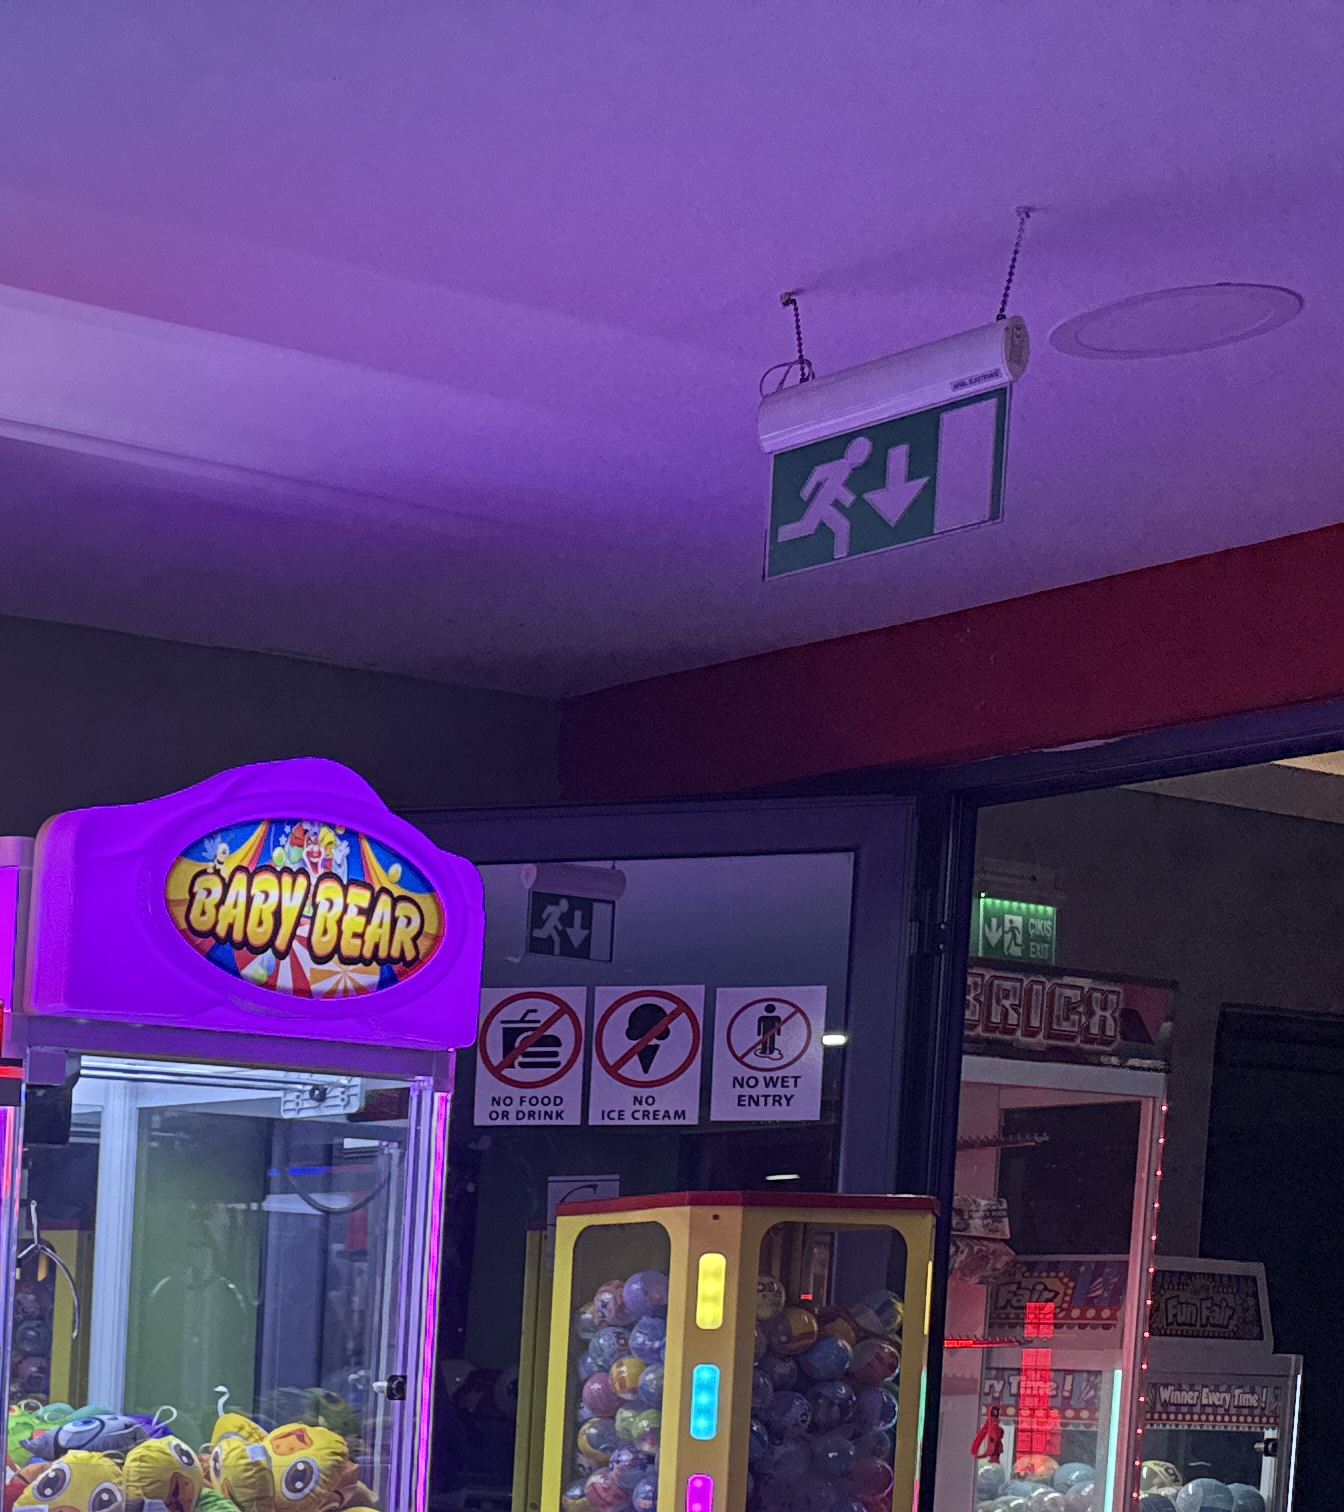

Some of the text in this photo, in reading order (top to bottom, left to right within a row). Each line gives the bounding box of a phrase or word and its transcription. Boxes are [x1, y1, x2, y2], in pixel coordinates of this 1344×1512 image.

[187, 864, 425, 964] BABY BEAR
[1029, 942, 1051, 958] EXIT
[732, 1075, 802, 1089] NO WET
[490, 1095, 565, 1108] NO FOOD
[632, 1094, 656, 1107] NO
[736, 1093, 795, 1108] ENTRY
[488, 1109, 565, 1122] OR DRINK
[600, 1109, 687, 1122] ICE CREAM
[1164, 1299, 1234, 1329] Fun Fair
[1160, 1385, 1199, 1406] Winner
[1201, 1387, 1231, 1408] Every
[1233, 1388, 1258, 1408] Time
